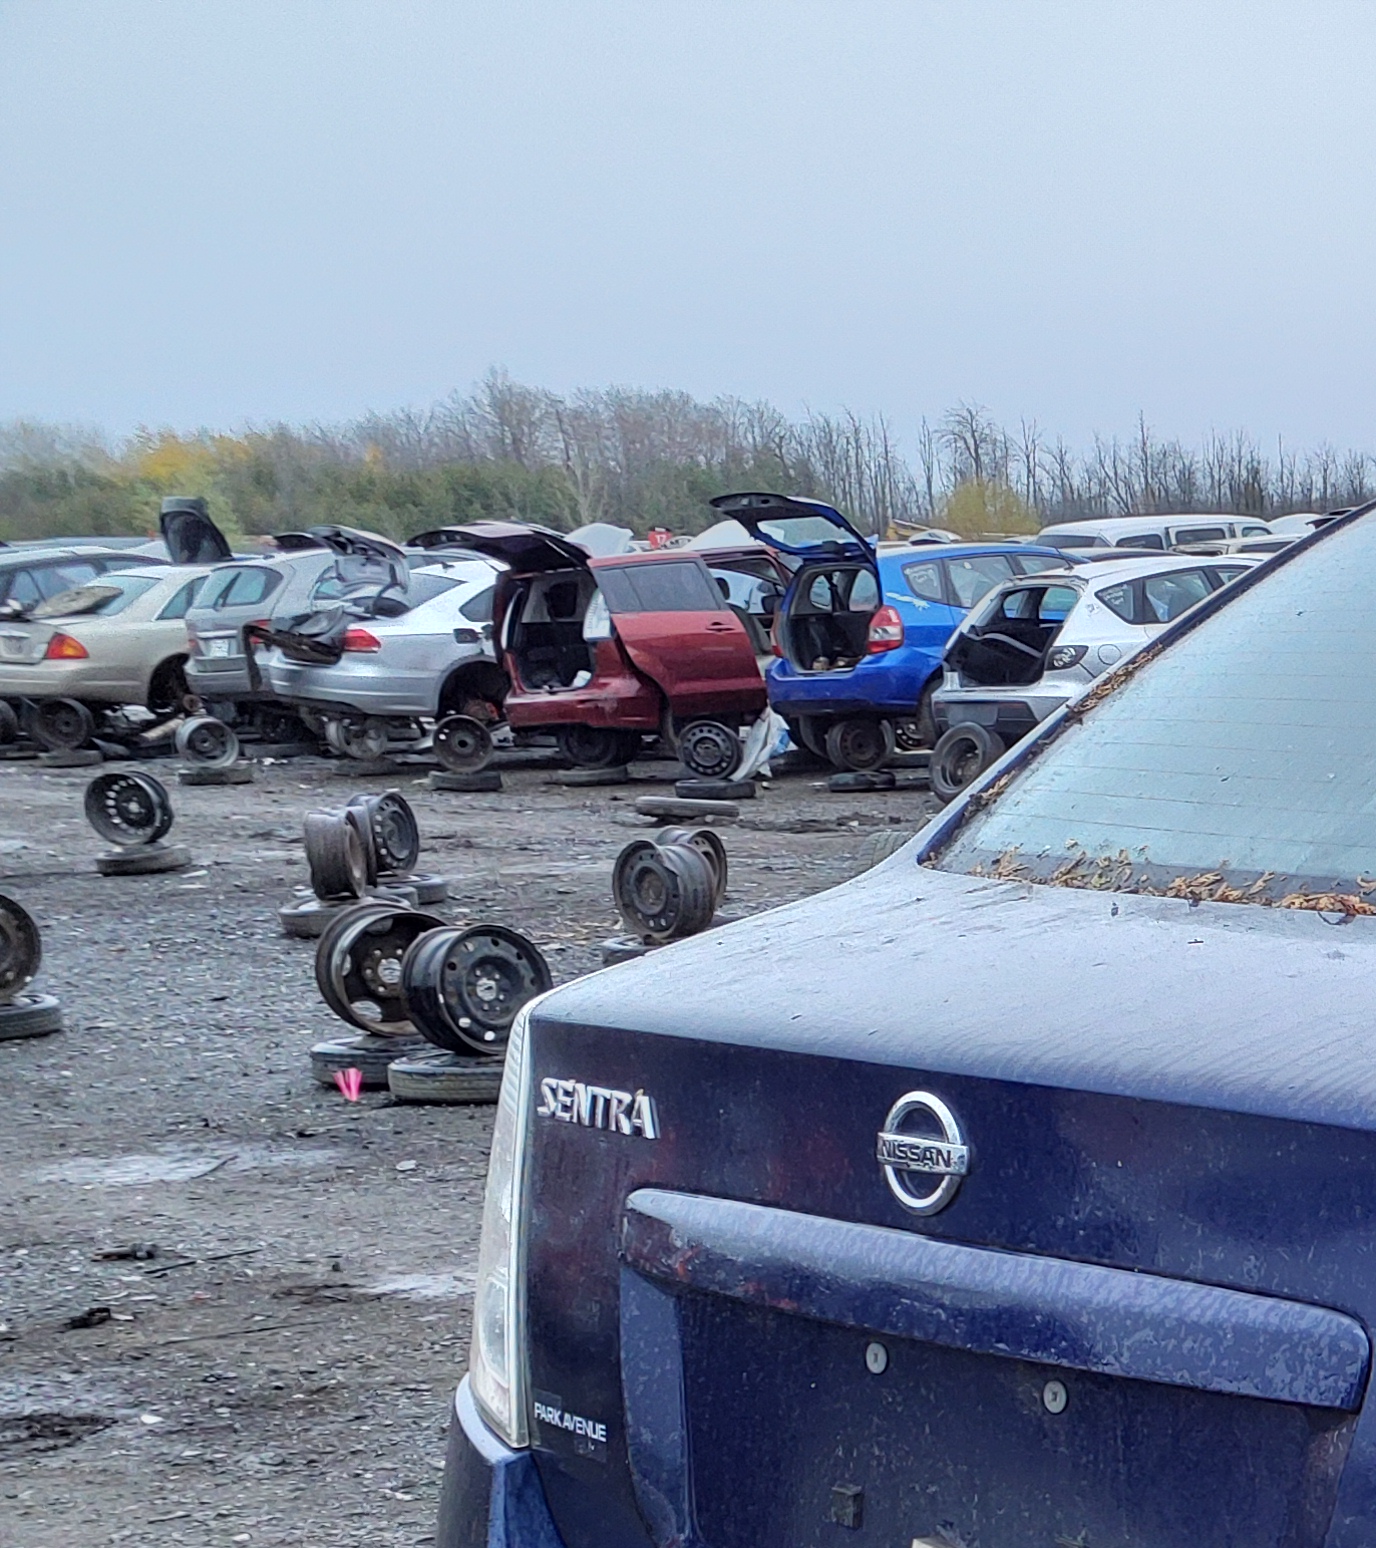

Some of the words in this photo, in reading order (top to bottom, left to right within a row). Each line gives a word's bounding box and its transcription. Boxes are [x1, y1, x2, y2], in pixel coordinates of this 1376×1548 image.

[537, 1077, 660, 1139] SENTRA
[881, 1139, 952, 1168] NISSAN
[534, 1401, 562, 1427] PARK
[563, 1412, 607, 1442] AVENUE
